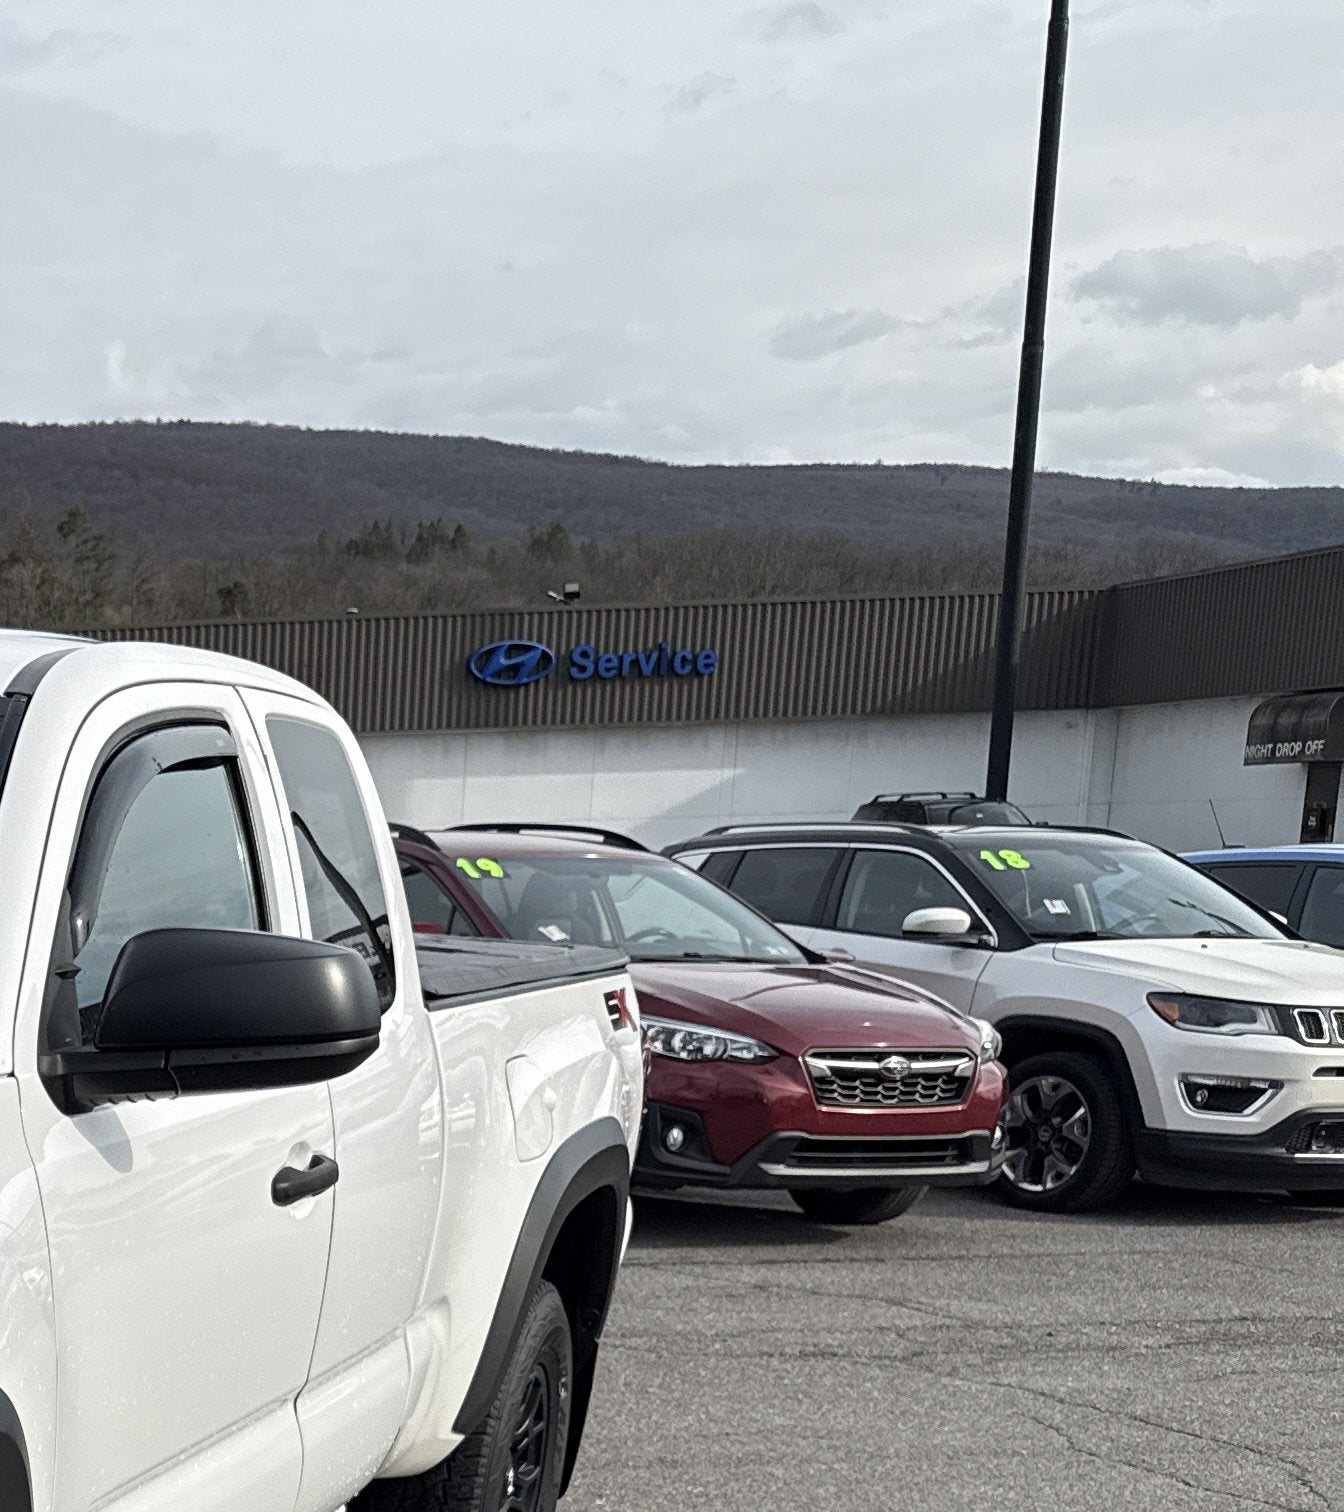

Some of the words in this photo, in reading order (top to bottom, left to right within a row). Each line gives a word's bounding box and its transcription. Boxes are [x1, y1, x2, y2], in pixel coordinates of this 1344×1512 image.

[568, 640, 718, 681] Service
[1245, 743, 1274, 759] NIGHT
[1275, 741, 1303, 758] DROP
[1304, 738, 1326, 755] OFF
[455, 857, 504, 879] 19
[980, 849, 1031, 871] 18
